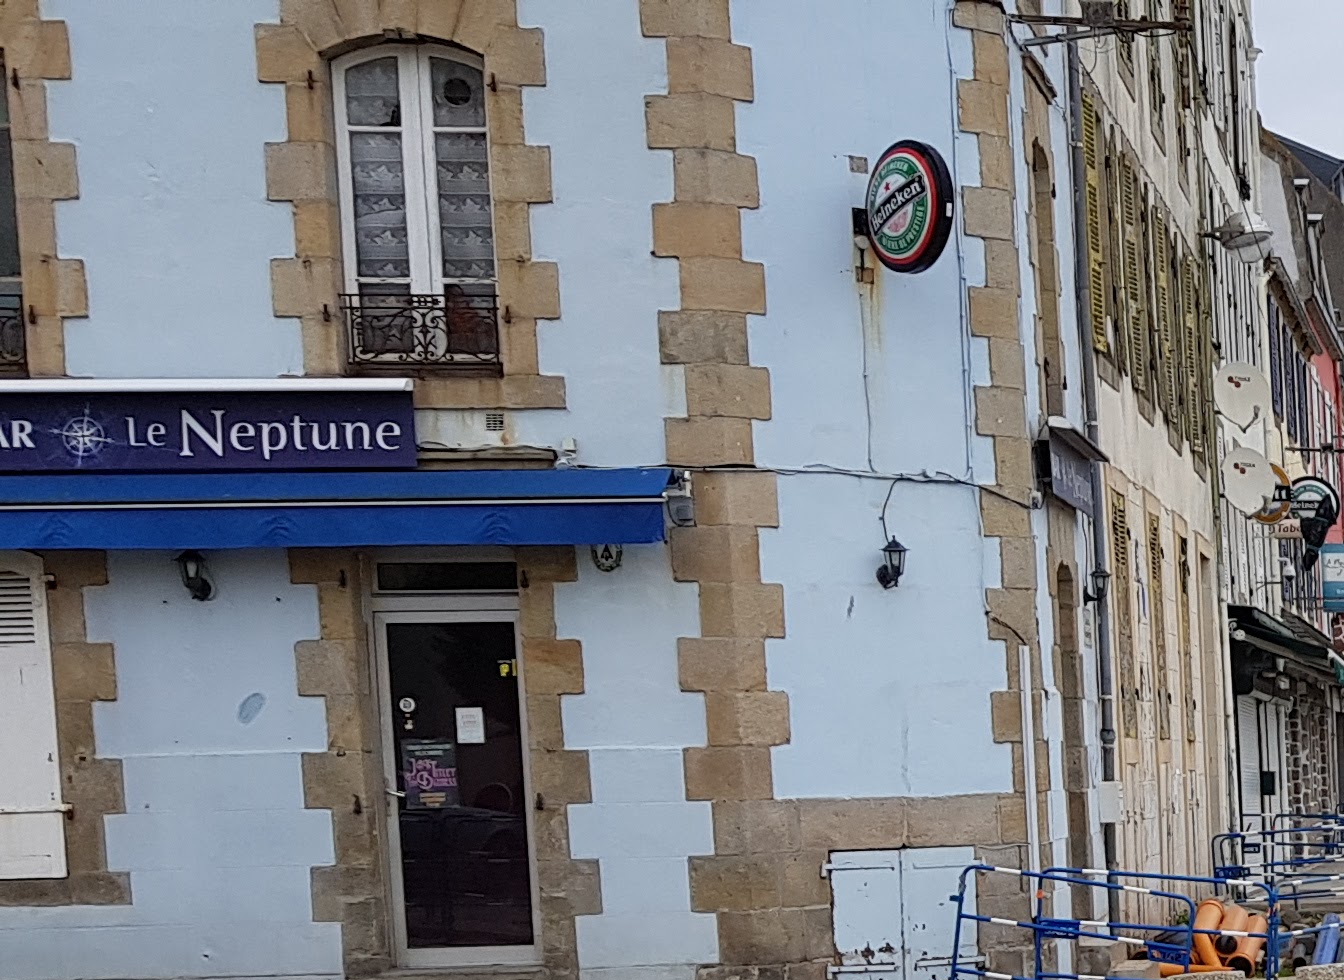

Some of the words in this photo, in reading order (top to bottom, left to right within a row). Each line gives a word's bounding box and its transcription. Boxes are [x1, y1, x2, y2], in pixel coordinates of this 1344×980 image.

[872, 180, 922, 232] Heineken
[125, 416, 166, 446] Le
[179, 409, 401, 460] Neptune
